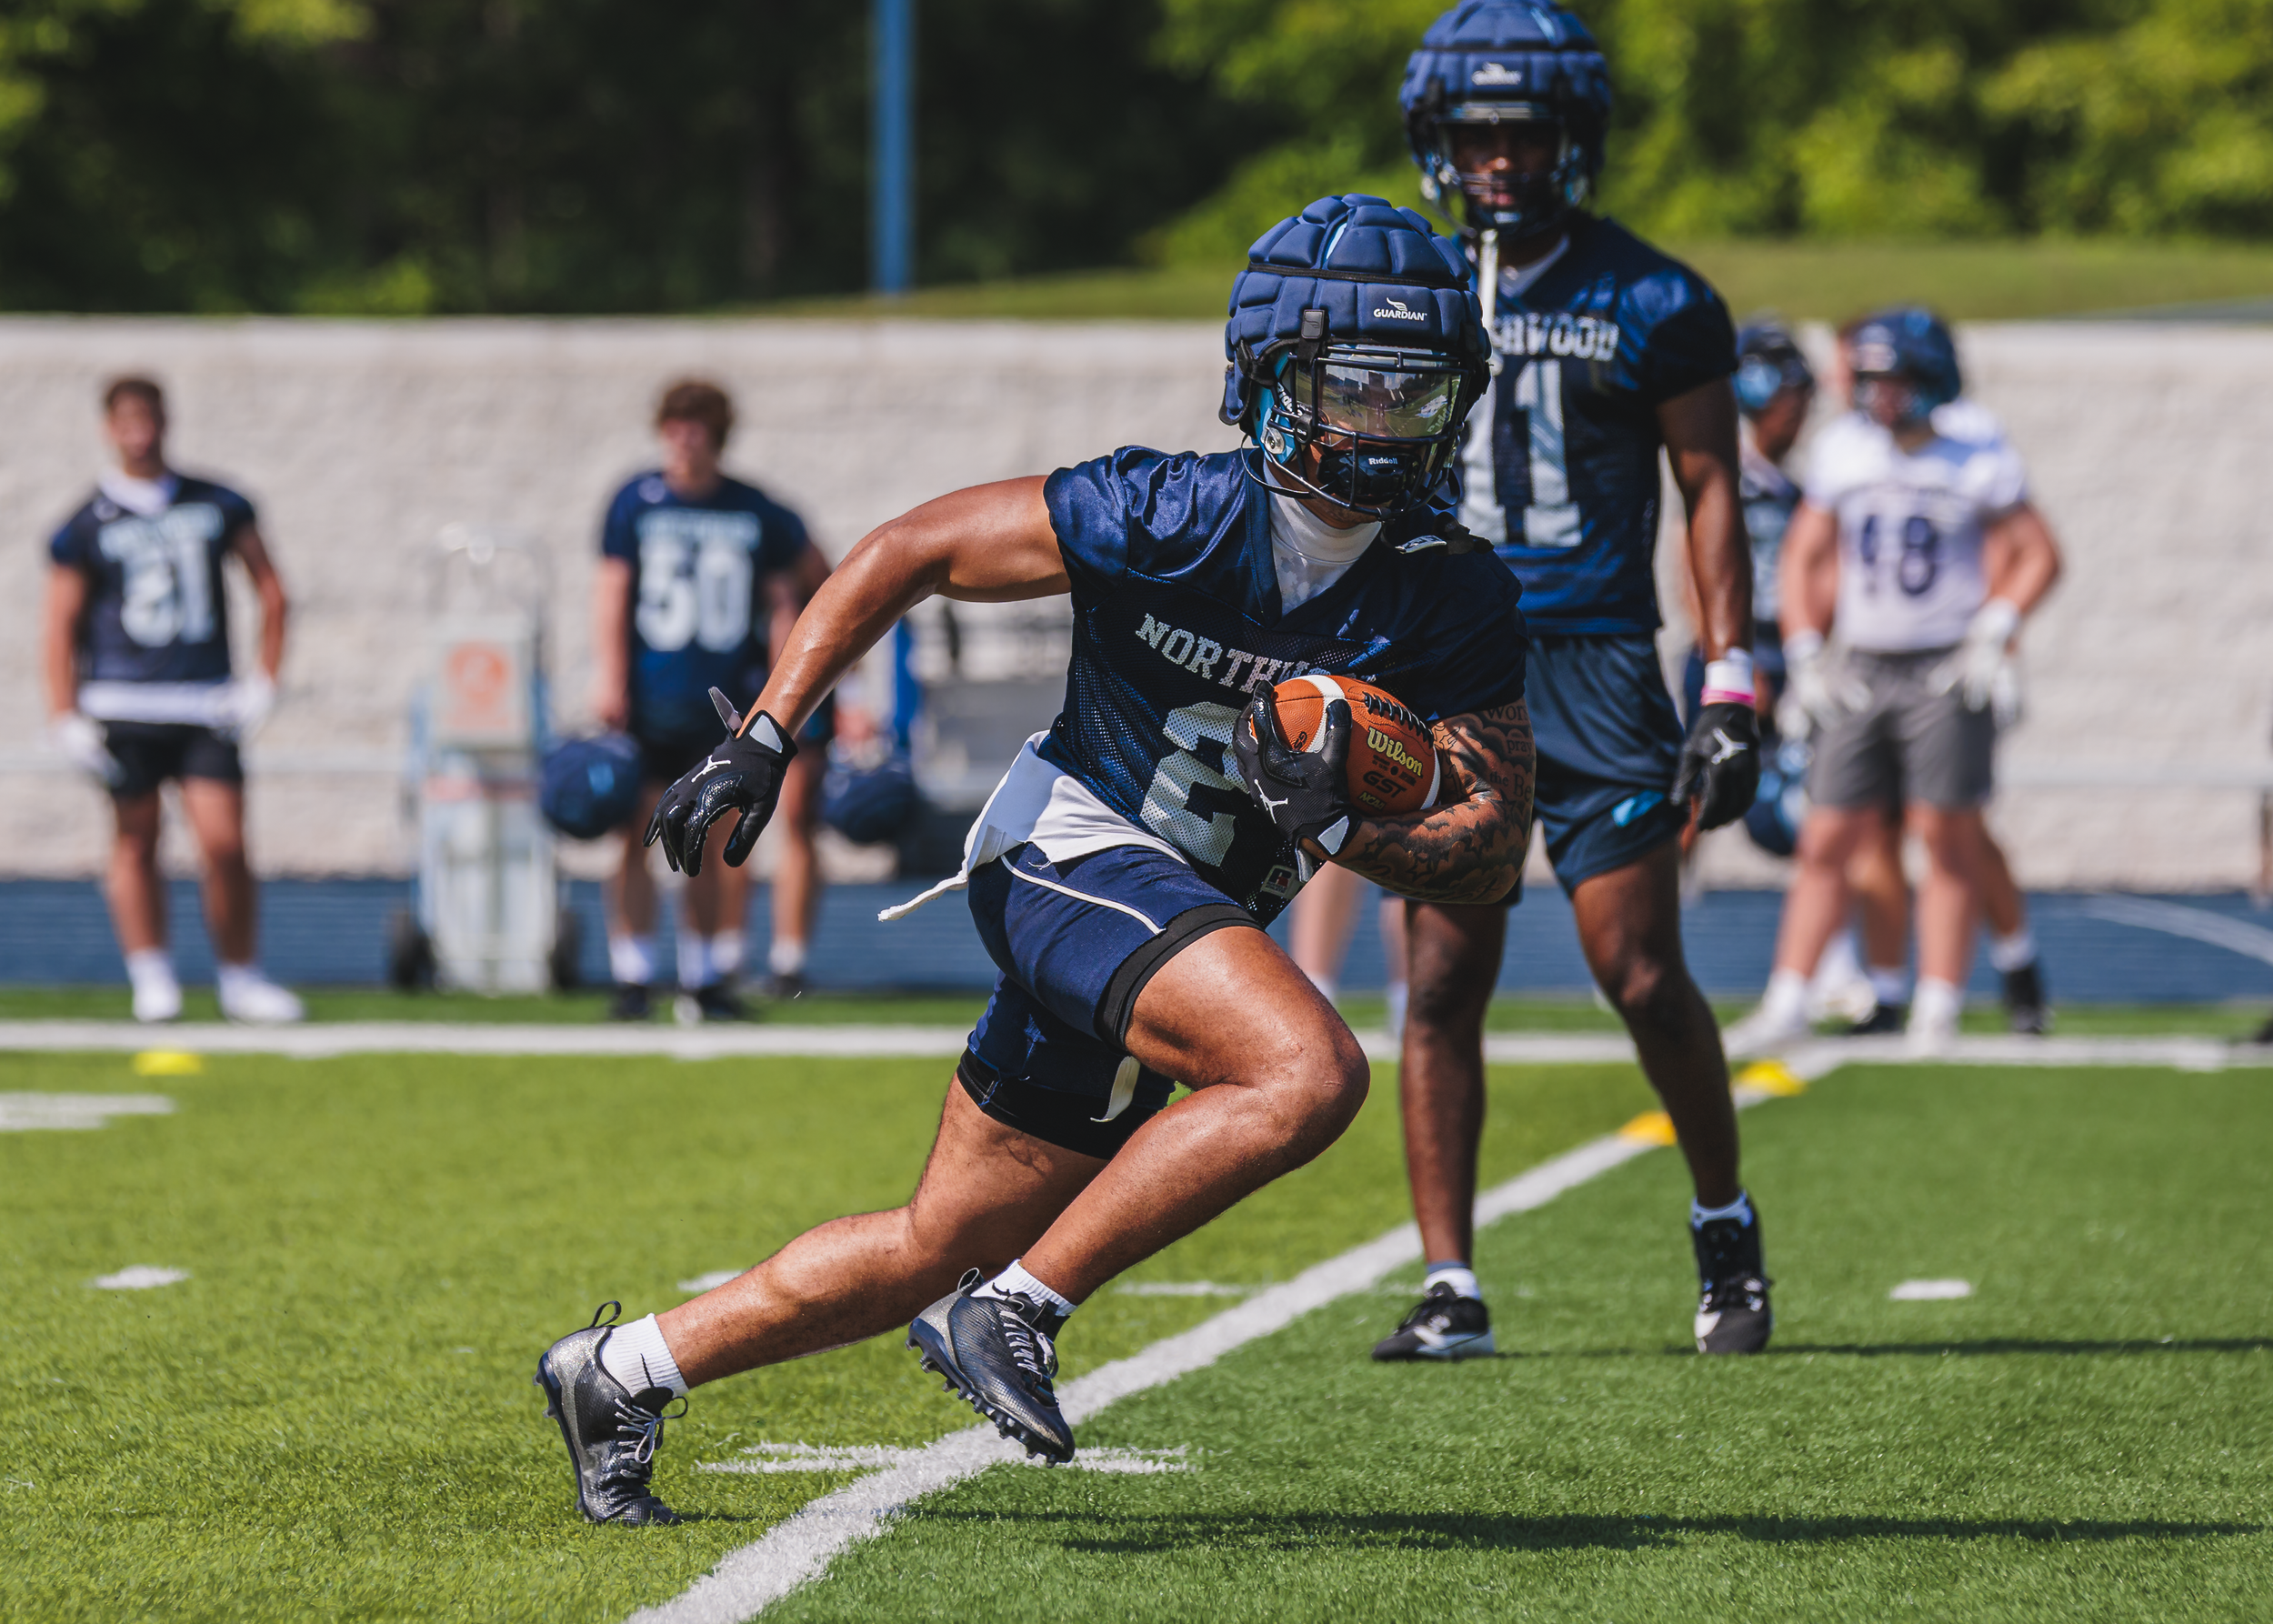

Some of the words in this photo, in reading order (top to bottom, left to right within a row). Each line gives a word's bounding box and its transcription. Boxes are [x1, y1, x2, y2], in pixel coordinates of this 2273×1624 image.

[1374, 308, 1425, 321] GUARDIAN
[1458, 358, 1582, 547] 11
[636, 538, 756, 653] 50
[1367, 727, 1423, 777] Wilson
[1140, 701, 1250, 867] 2
[1359, 792, 1386, 810] NCAA
[1363, 770, 1407, 798] GST
